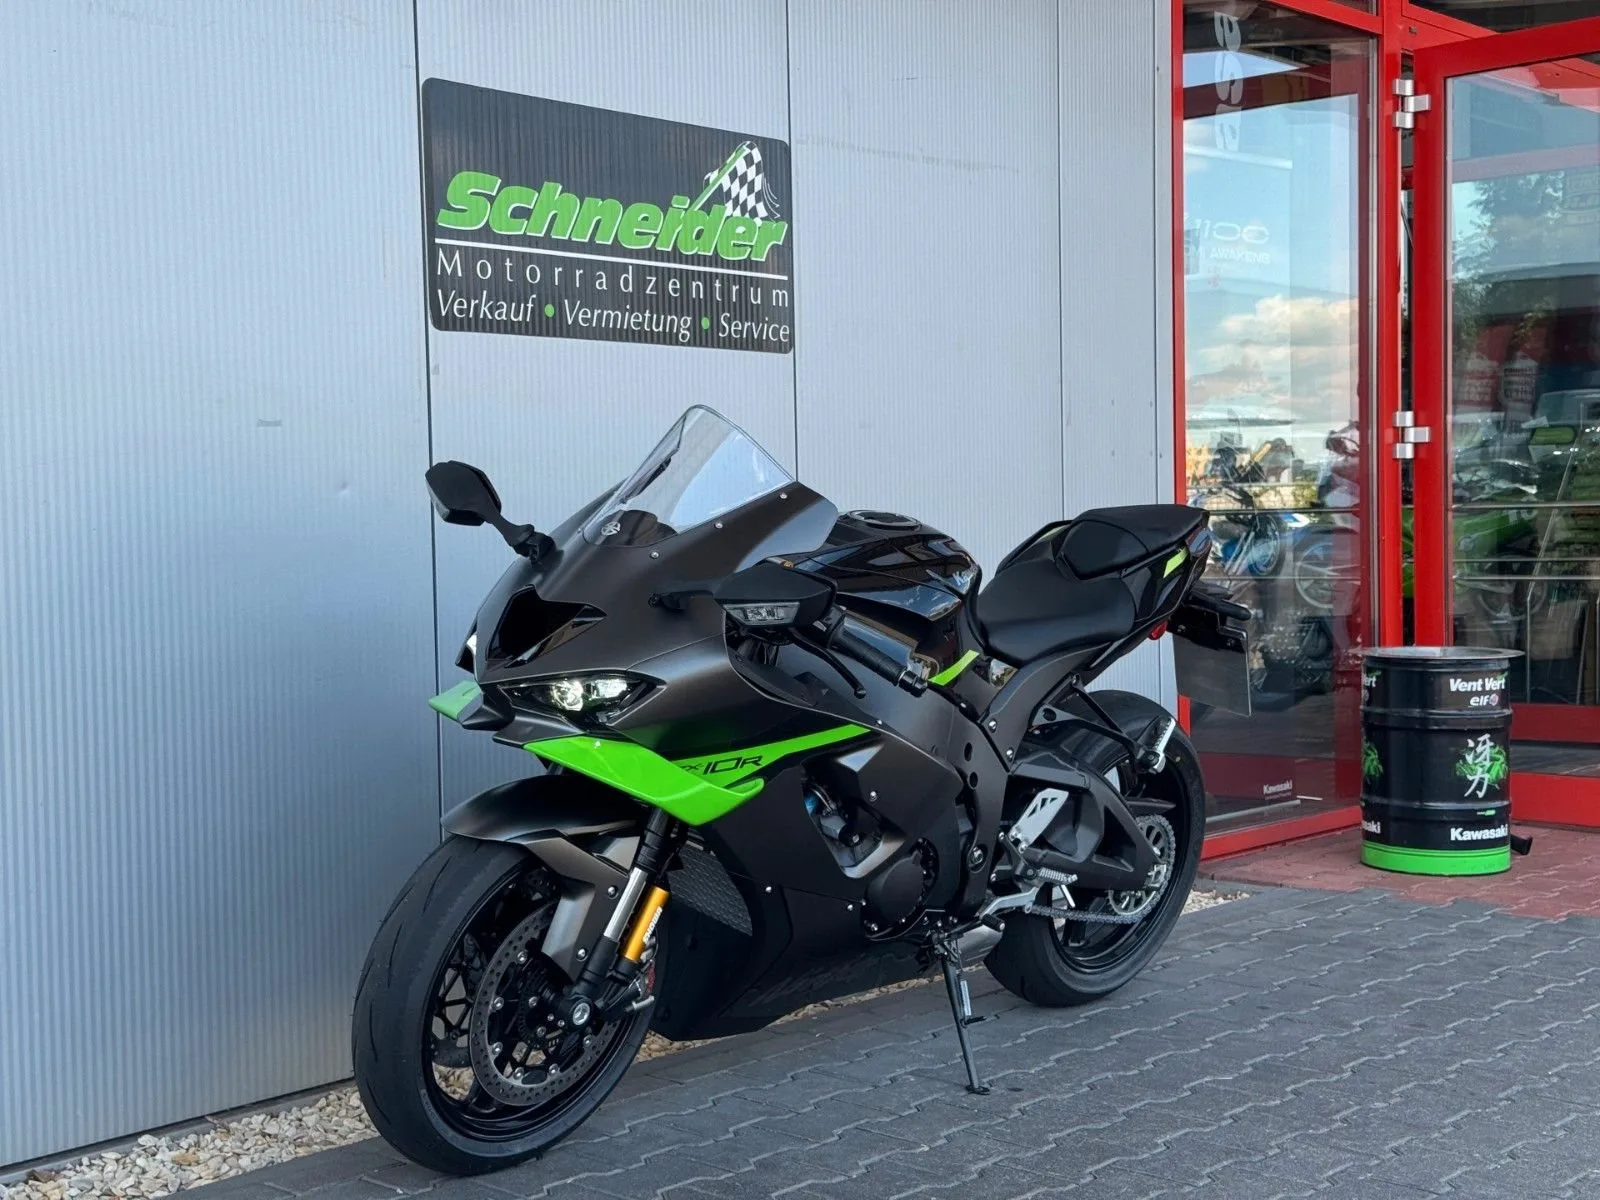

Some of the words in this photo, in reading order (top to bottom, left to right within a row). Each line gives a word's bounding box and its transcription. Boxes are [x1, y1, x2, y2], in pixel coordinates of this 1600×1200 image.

[436, 171, 788, 261] Schneider
[437, 248, 789, 307] Motorradzentrum
[437, 289, 537, 322] Verkauf
[564, 299, 692, 342] Vermietung
[718, 312, 790, 342] Service
[1449, 677, 1483, 692] Vent
[1485, 675, 1506, 691] Vert
[1469, 694, 1490, 706] elf
[1450, 823, 1508, 842] Kawasaki
